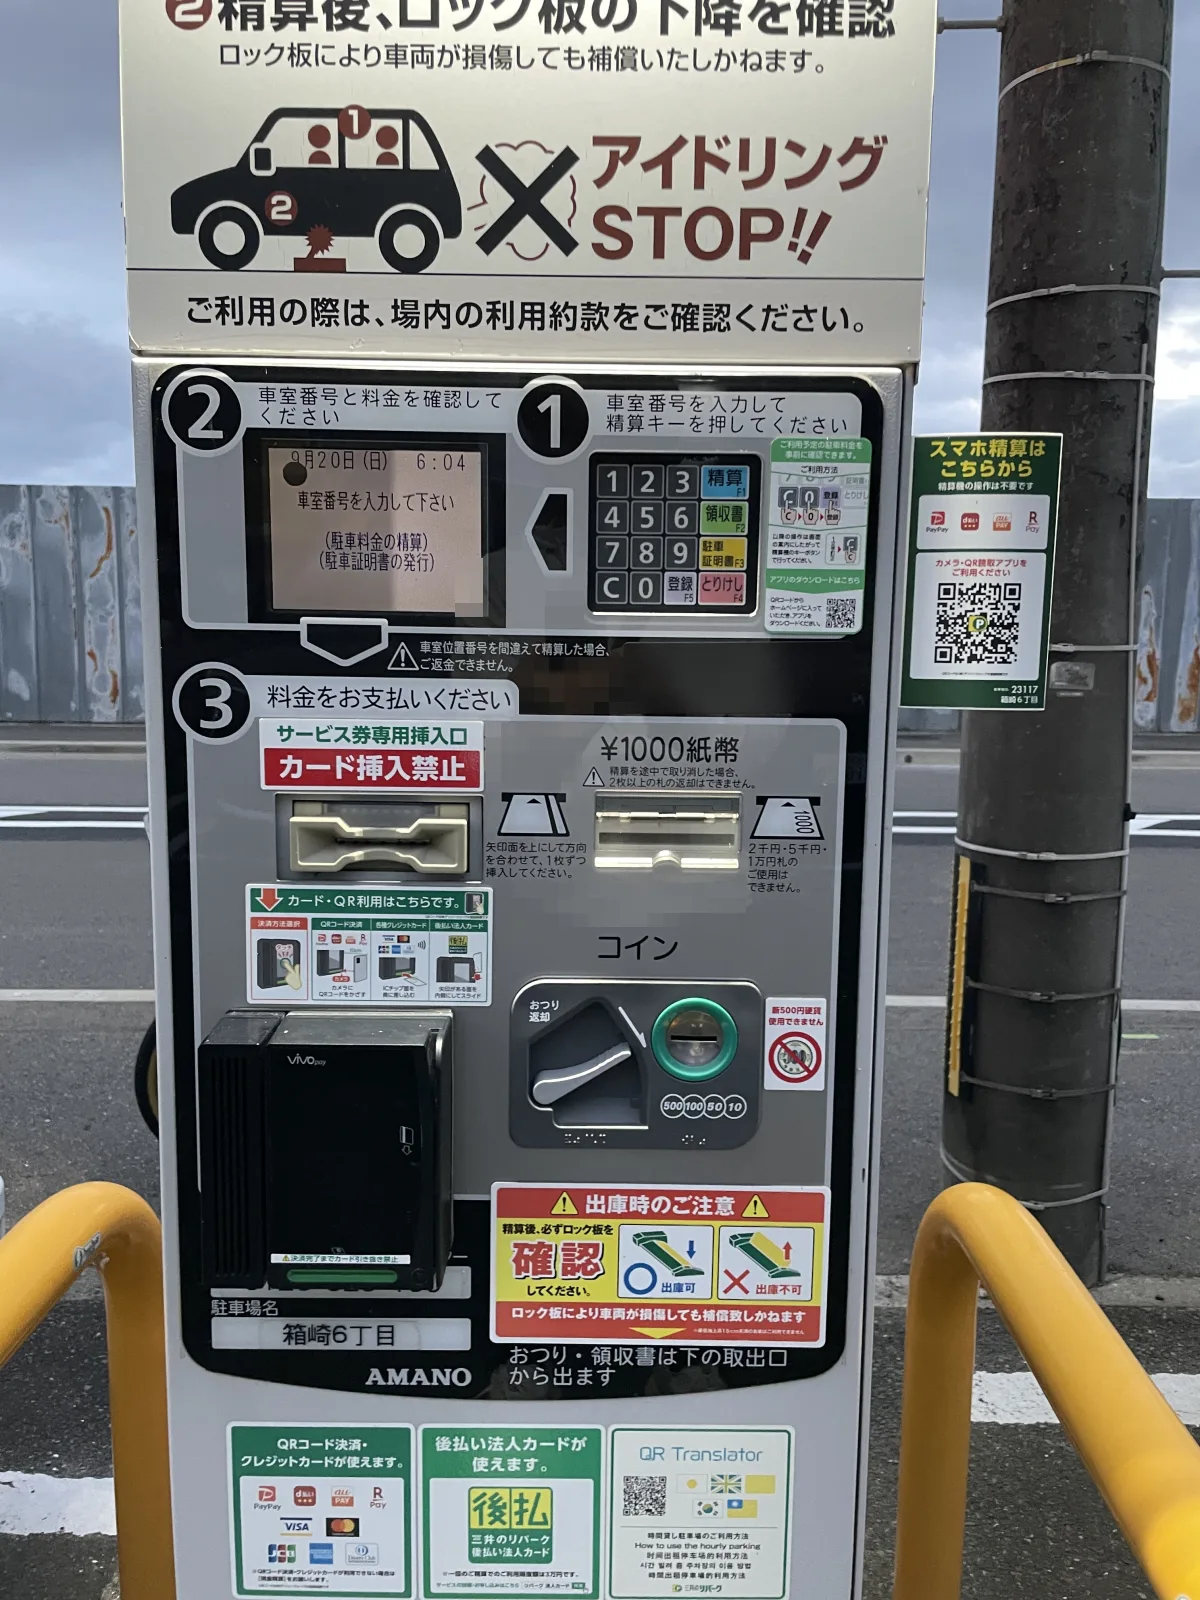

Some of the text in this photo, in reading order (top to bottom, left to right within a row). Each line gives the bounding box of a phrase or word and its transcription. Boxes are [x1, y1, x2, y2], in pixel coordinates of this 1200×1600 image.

[219, 43, 825, 74] ロック板により車両が損傷しても補償いたしかねます。
[348, 109, 359, 135] 1
[592, 134, 889, 192] アイドリング
[271, 195, 292, 220] 2
[591, 205, 833, 265] STOP!!
[187, 296, 866, 334] ご利用の際は、場内の利用約款をご確認ください。
[259, 386, 502, 410] 車室番号と料金を確認して
[606, 394, 786, 414] 車室番号を入力して
[187, 384, 224, 439] 2
[260, 408, 340, 426] ください
[537, 394, 562, 449] 1
[606, 414, 849, 435] 精算キーを押してください
[929, 439, 1046, 458] スマホ精算は
[416, 453, 466, 472] 6:04
[800, 465, 839, 474] ご利用方法
[940, 460, 1033, 478] こちらから
[606, 470, 617, 493] 1
[640, 470, 655, 493] 2
[675, 471, 690, 494] 3
[707, 469, 743, 487] 精算
[938, 481, 1034, 492] 精算機の操作は不要です
[736, 487, 746, 497] F1
[298, 491, 455, 513] 車室番号を入力して下さい
[604, 506, 620, 528] 4
[640, 506, 655, 529] 5
[674, 506, 689, 529] 6
[706, 504, 743, 523] 領収書
[736, 524, 746, 533] F2
[325, 531, 428, 552] (駐車料金の精算)
[702, 540, 724, 552] 駐車
[605, 541, 620, 564] 7
[639, 541, 655, 564] 8
[673, 541, 689, 565] 9
[702, 555, 734, 567] 証明書
[319, 551, 435, 573] (駐車証明書の発行)
[734, 558, 745, 568] F3
[769, 575, 861, 584] アプリのダウンロードはこちら
[951, 568, 1011, 577] ご利用ください
[603, 576, 620, 599] C
[638, 576, 654, 599] 0
[667, 576, 693, 592] 登録
[701, 576, 743, 592] とりけし
[684, 594, 694, 603] F5
[734, 594, 744, 603] F4
[419, 640, 611, 657] 車室位置番号を間違えて精算した場合、
[420, 658, 514, 673] ご返金できません。
[267, 684, 511, 711] 料金をお支払いください
[1011, 685, 1038, 694] 23117
[199, 677, 233, 730] 3
[276, 725, 467, 747] サービス券専用挿入口
[600, 736, 740, 764] ¥1000紙幣
[279, 754, 467, 781] カード挿入禁止
[609, 766, 739, 778] 精算を途中で取り消した場合、
[609, 777, 756, 789] 2枚以上の札の返却はできません。
[485, 841, 587, 854] 矢印面を上にして方向
[485, 854, 587, 866] を合わせて、1枚ずつ
[748, 856, 799, 867] 1万円札の
[485, 867, 573, 879] 挿入してください。
[747, 868, 788, 880] ご使用は
[747, 882, 801, 893] できません。
[287, 894, 460, 910] カード・QR利用はこちらです。
[597, 935, 678, 961] コイン
[529, 1000, 560, 1011] おつり
[528, 1011, 551, 1023] 返却
[768, 1017, 824, 1026] 使用できません
[663, 1101, 683, 1111] 500
[685, 1101, 703, 1111] 100
[707, 1102, 723, 1112] 50
[728, 1102, 743, 1112] 10
[585, 1194, 736, 1217] 出庫時のご注意
[502, 1222, 614, 1236] 精算後、必ずロック板を
[511, 1239, 605, 1280] 確認
[525, 1284, 592, 1297] してください。
[660, 1281, 697, 1294] 出庫可
[755, 1283, 802, 1296] 出庫不可
[210, 1300, 279, 1316] 駐車場名
[511, 1306, 806, 1324] ロック板により車両が損傷しても補償致しかねます
[282, 1323, 395, 1347] 箱崎6丁目
[509, 1346, 788, 1368] おつり・領収書は下の取出口
[365, 1367, 472, 1386] AMANO
[509, 1367, 616, 1387] から出ます
[276, 1438, 368, 1451] QRコード決済・
[435, 1435, 587, 1452] 後払い法人カードが
[240, 1455, 404, 1469] クレジットカードが使えます。
[639, 1446, 764, 1462] QR Translator
[472, 1456, 548, 1473] 使えます。
[369, 1501, 386, 1509] Pay
[472, 1491, 550, 1527] 後払
[284, 1522, 310, 1531] VISA
[471, 1547, 550, 1558] 後払い法人カード
[700, 1542, 727, 1550] hourly
